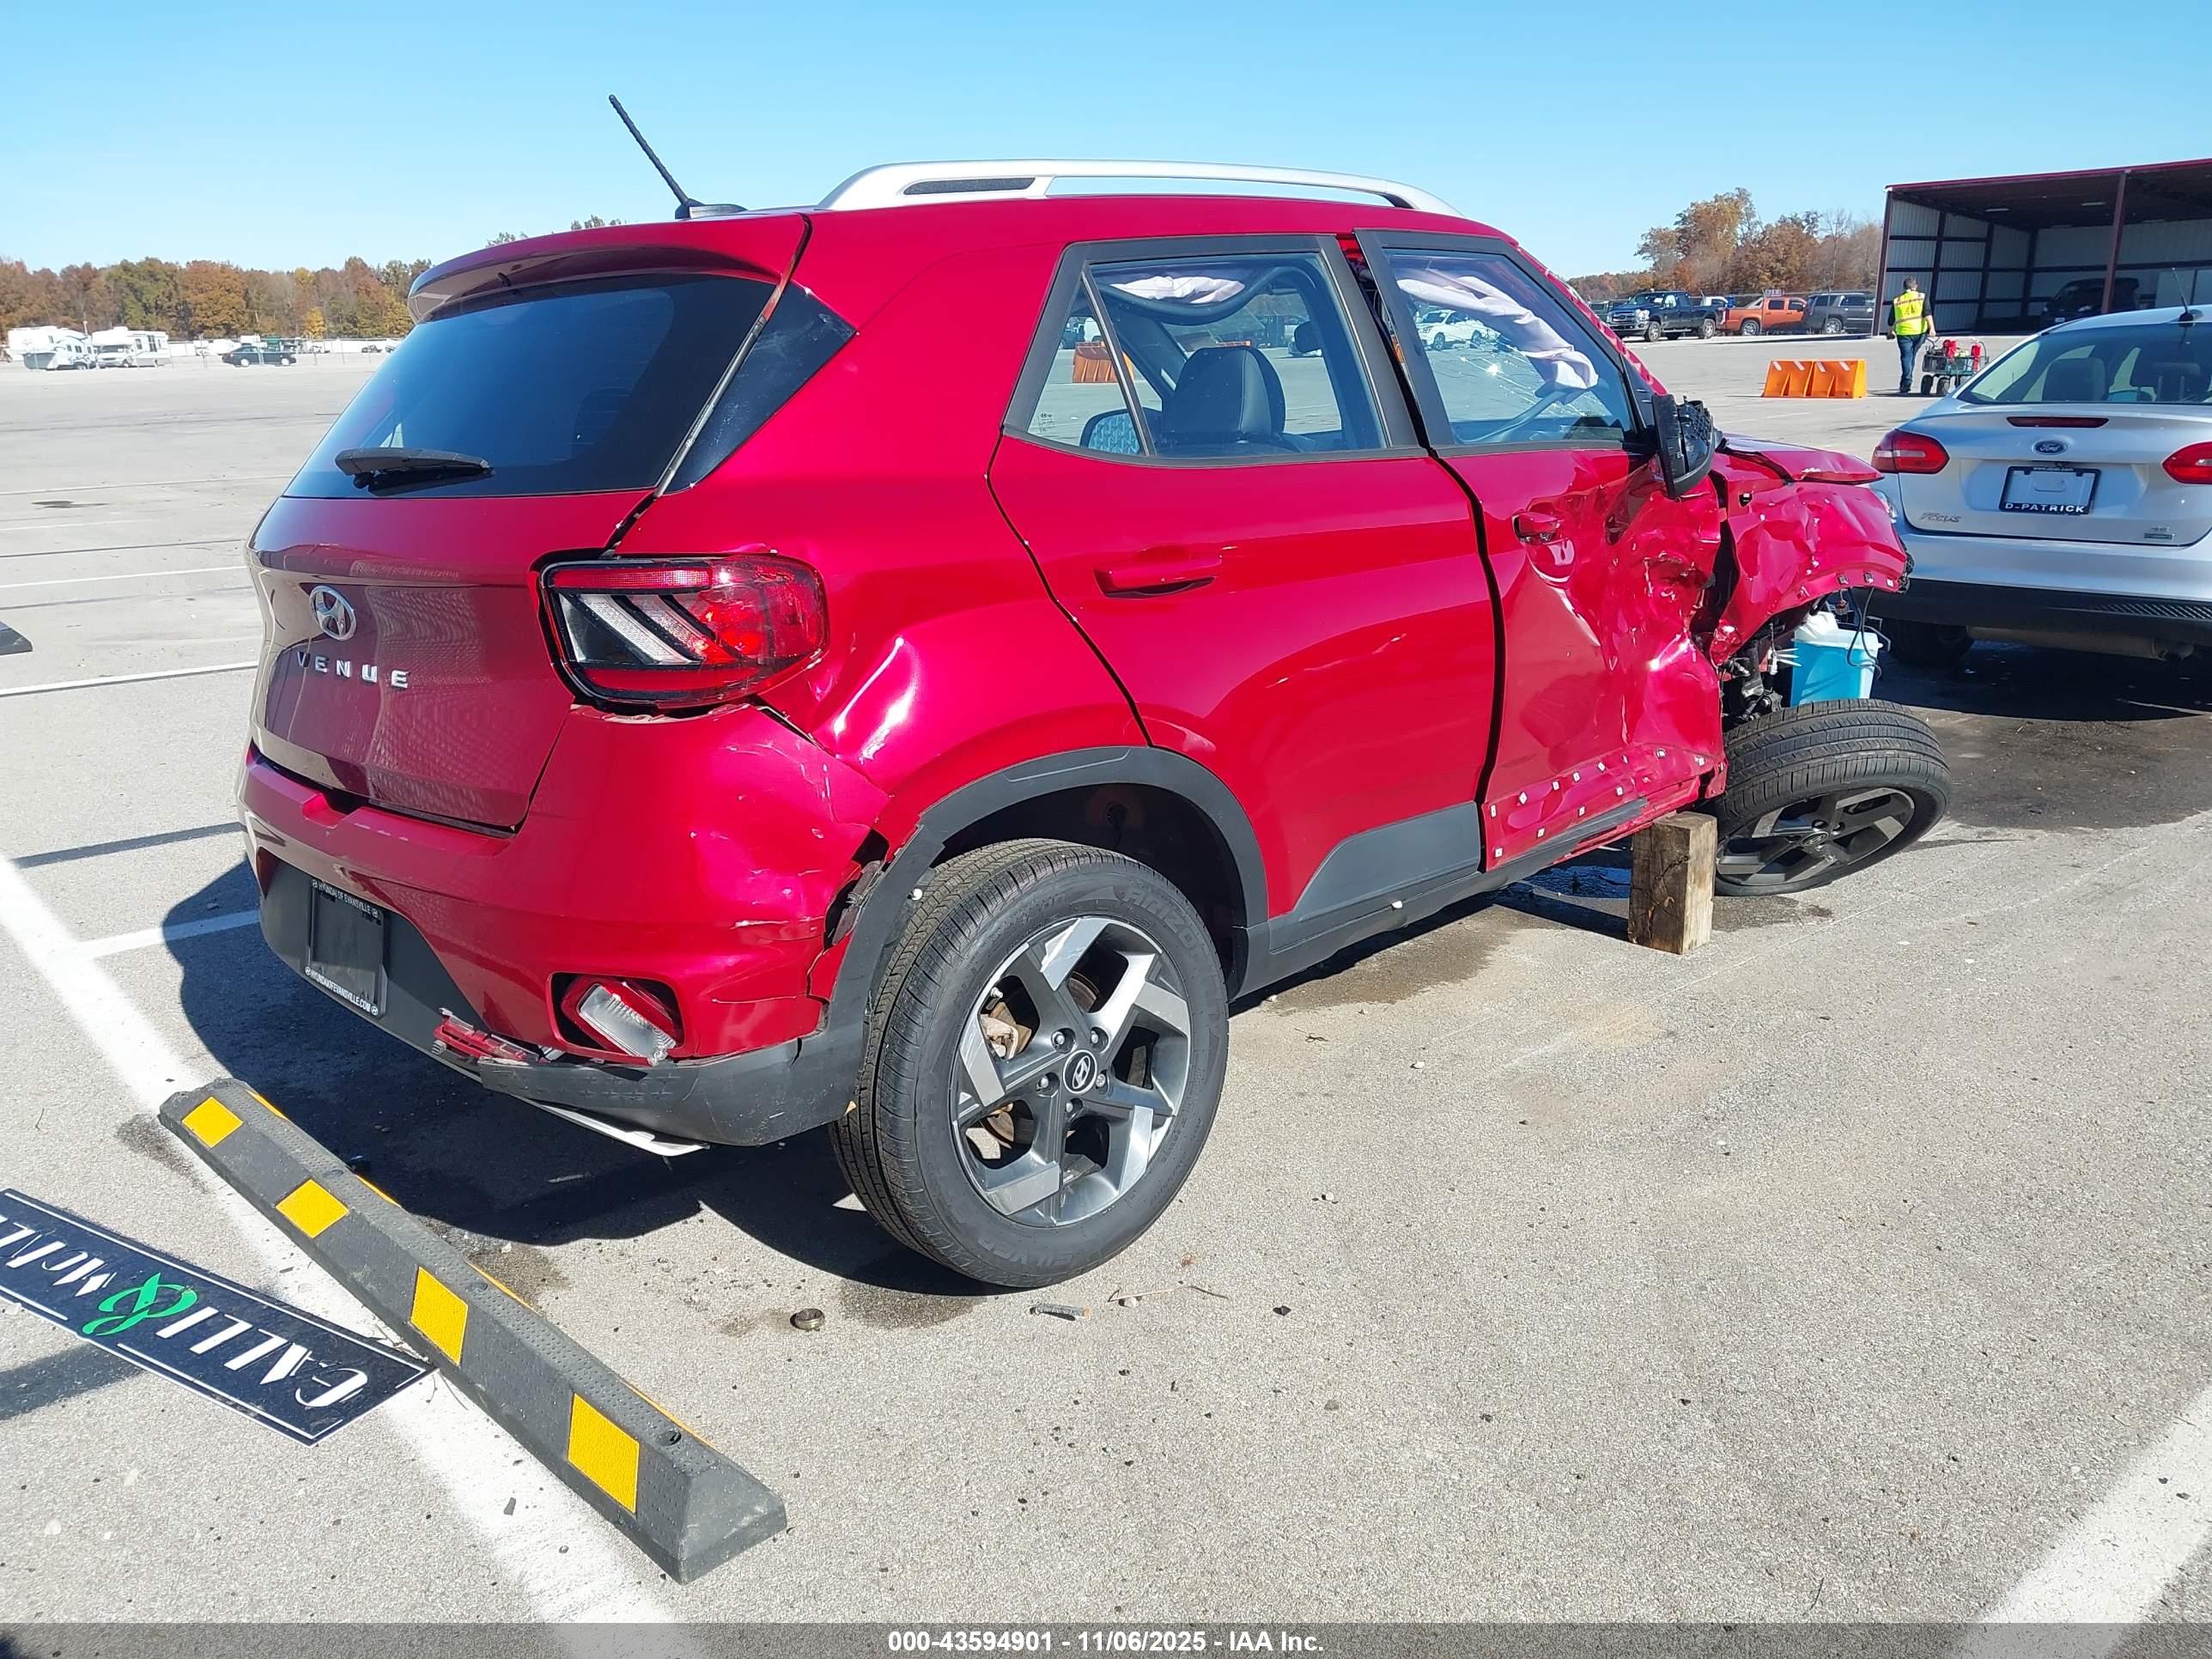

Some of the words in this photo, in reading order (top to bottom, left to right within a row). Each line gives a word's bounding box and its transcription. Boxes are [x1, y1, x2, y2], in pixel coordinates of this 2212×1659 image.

[2005, 502, 2086, 514] D-PATRICK
[296, 651, 410, 690] VENUE
[82, 1272, 198, 1336] &
